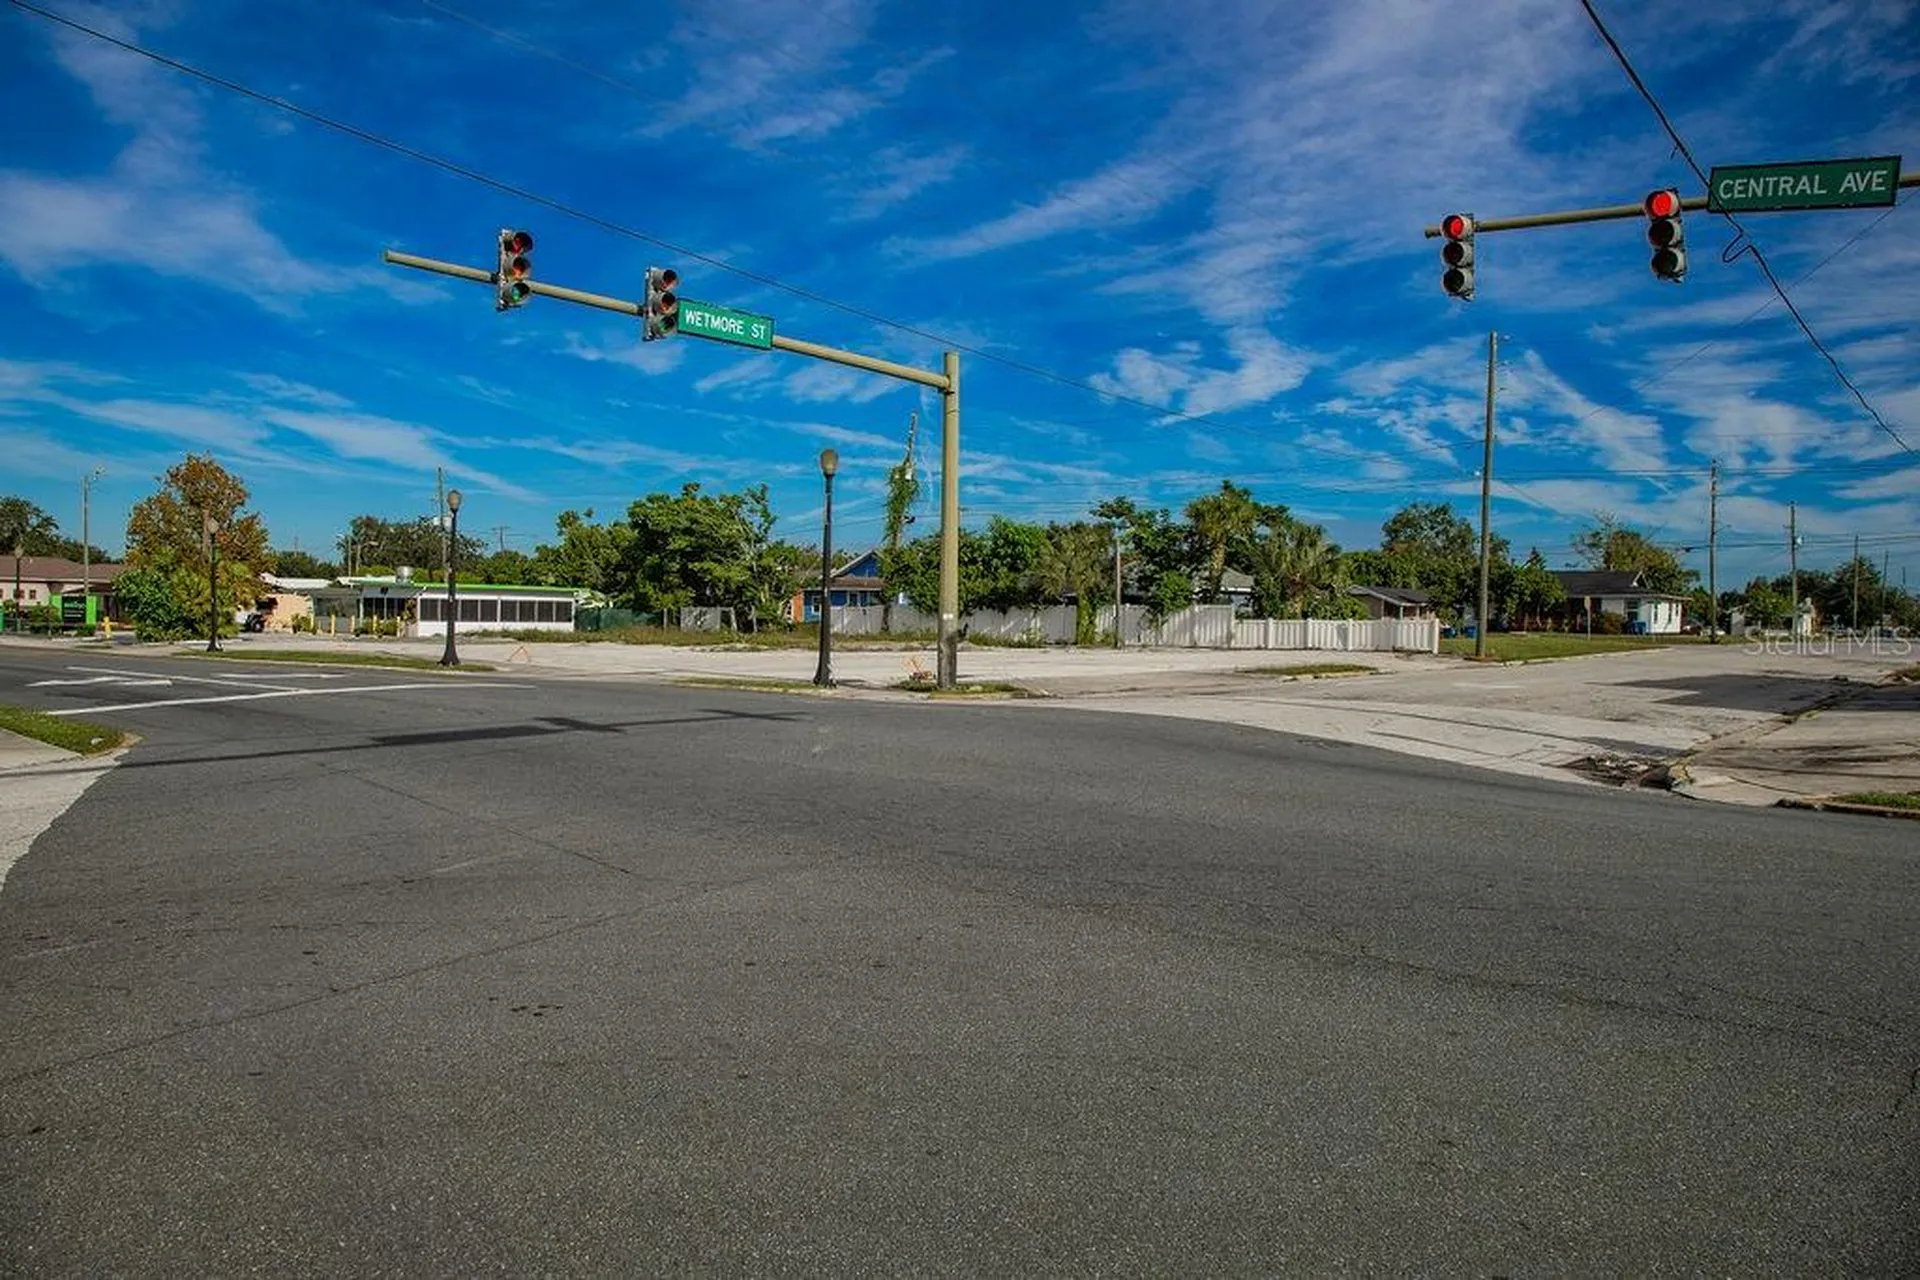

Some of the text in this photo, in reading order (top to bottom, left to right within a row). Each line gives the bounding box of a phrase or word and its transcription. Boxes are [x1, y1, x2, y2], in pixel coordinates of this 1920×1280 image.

[1719, 170, 1888, 199] CENTRAL AVE
[685, 309, 768, 339] WETMORE ST
